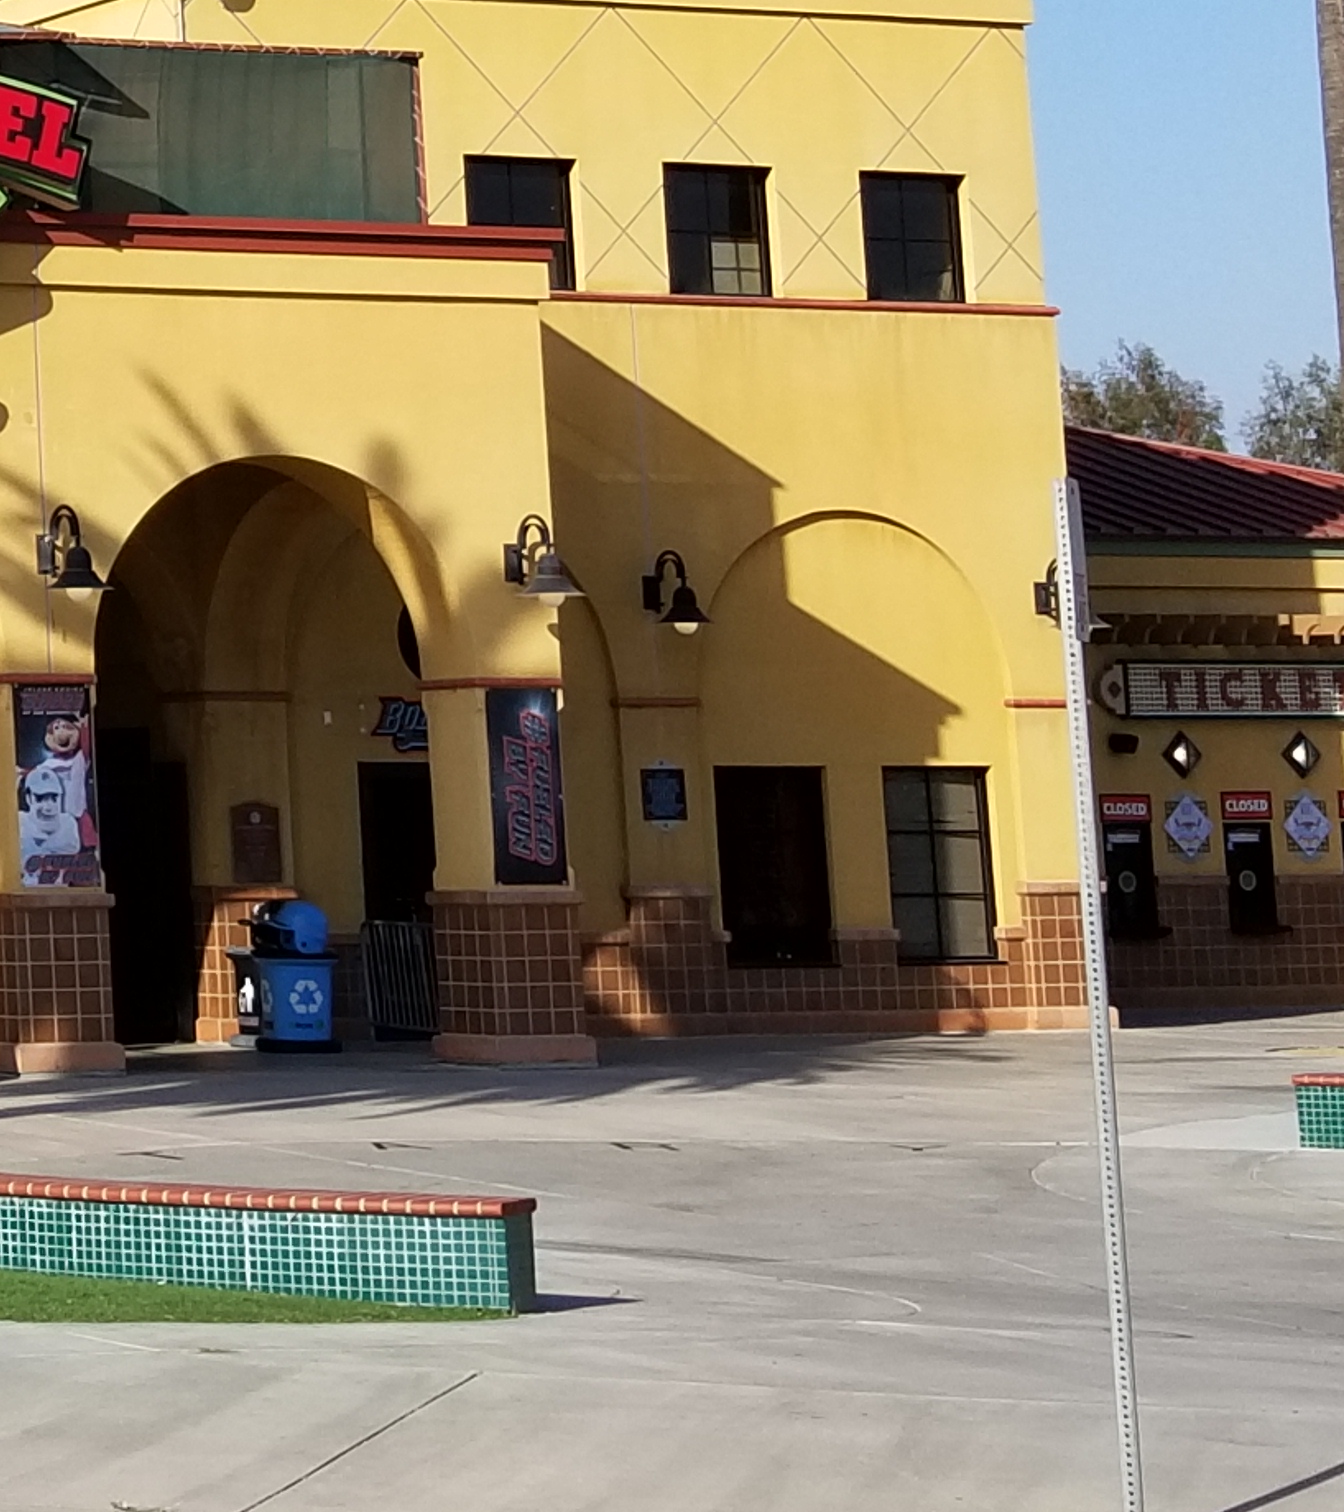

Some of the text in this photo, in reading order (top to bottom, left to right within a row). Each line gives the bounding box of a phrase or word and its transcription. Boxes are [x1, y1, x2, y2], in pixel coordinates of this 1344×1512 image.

[508, 743, 532, 857] BY FUN
[522, 713, 553, 862] #FUELED
[1103, 802, 1148, 816] CLOSED
[1225, 799, 1268, 812] CLOSED
